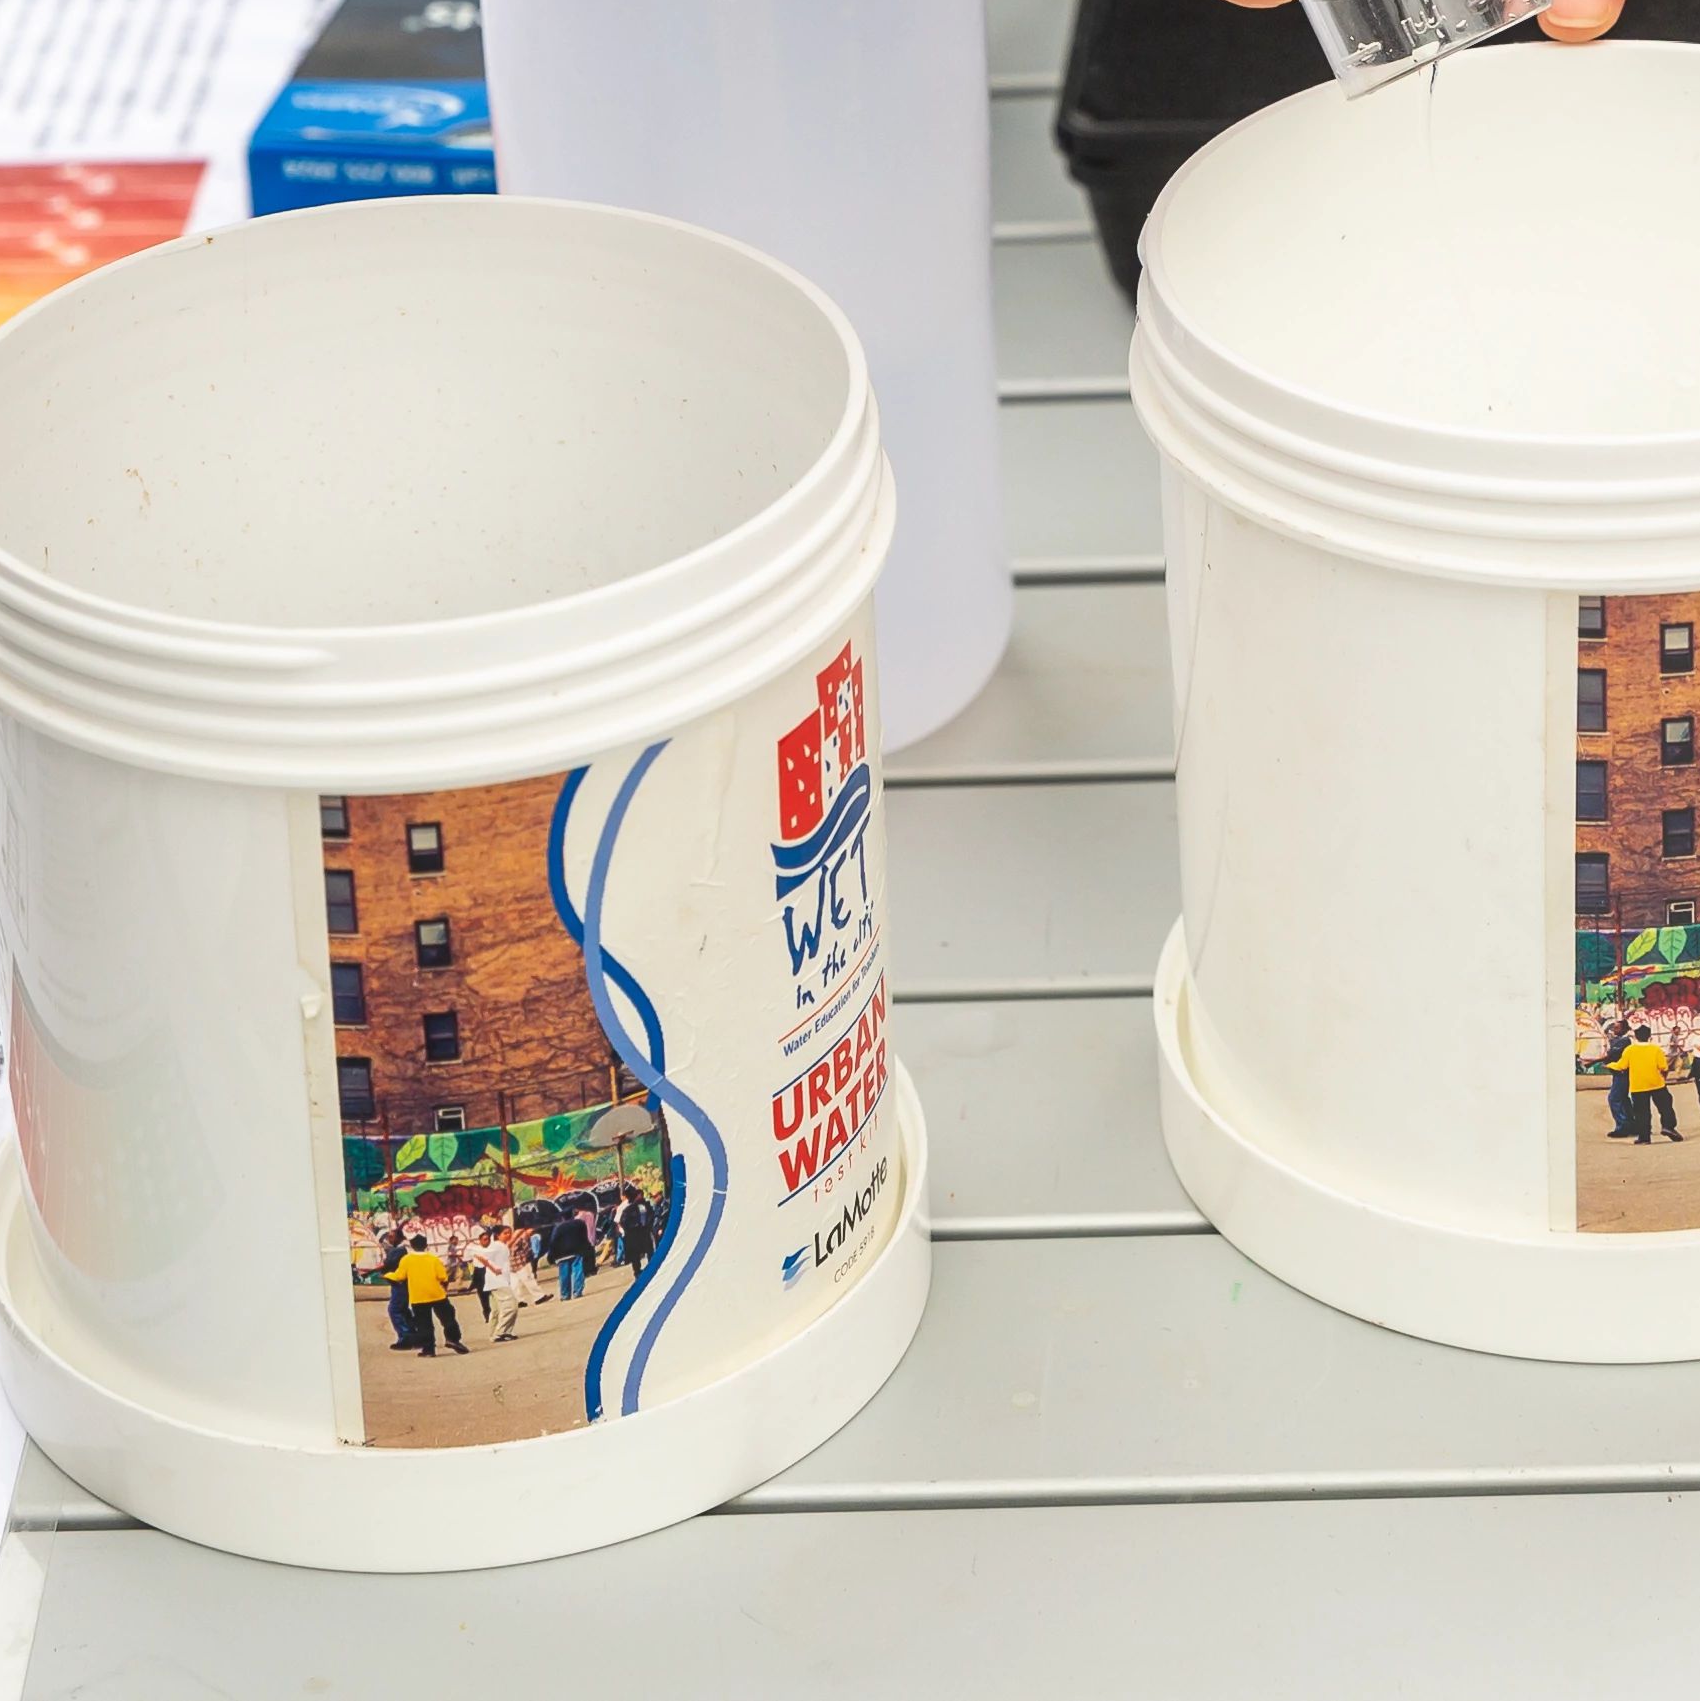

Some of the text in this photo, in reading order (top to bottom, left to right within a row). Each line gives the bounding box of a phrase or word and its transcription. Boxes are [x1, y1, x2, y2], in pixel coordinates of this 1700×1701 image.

[783, 811, 871, 977] WET
[822, 941, 846, 988] the
[773, 973, 887, 1142] URBAN
[783, 1028, 812, 1057] Water
[814, 986, 851, 1033] Education
[778, 1038, 888, 1193] WATER
[813, 1151, 854, 1203] test
[814, 1156, 887, 1268] LaMotte
